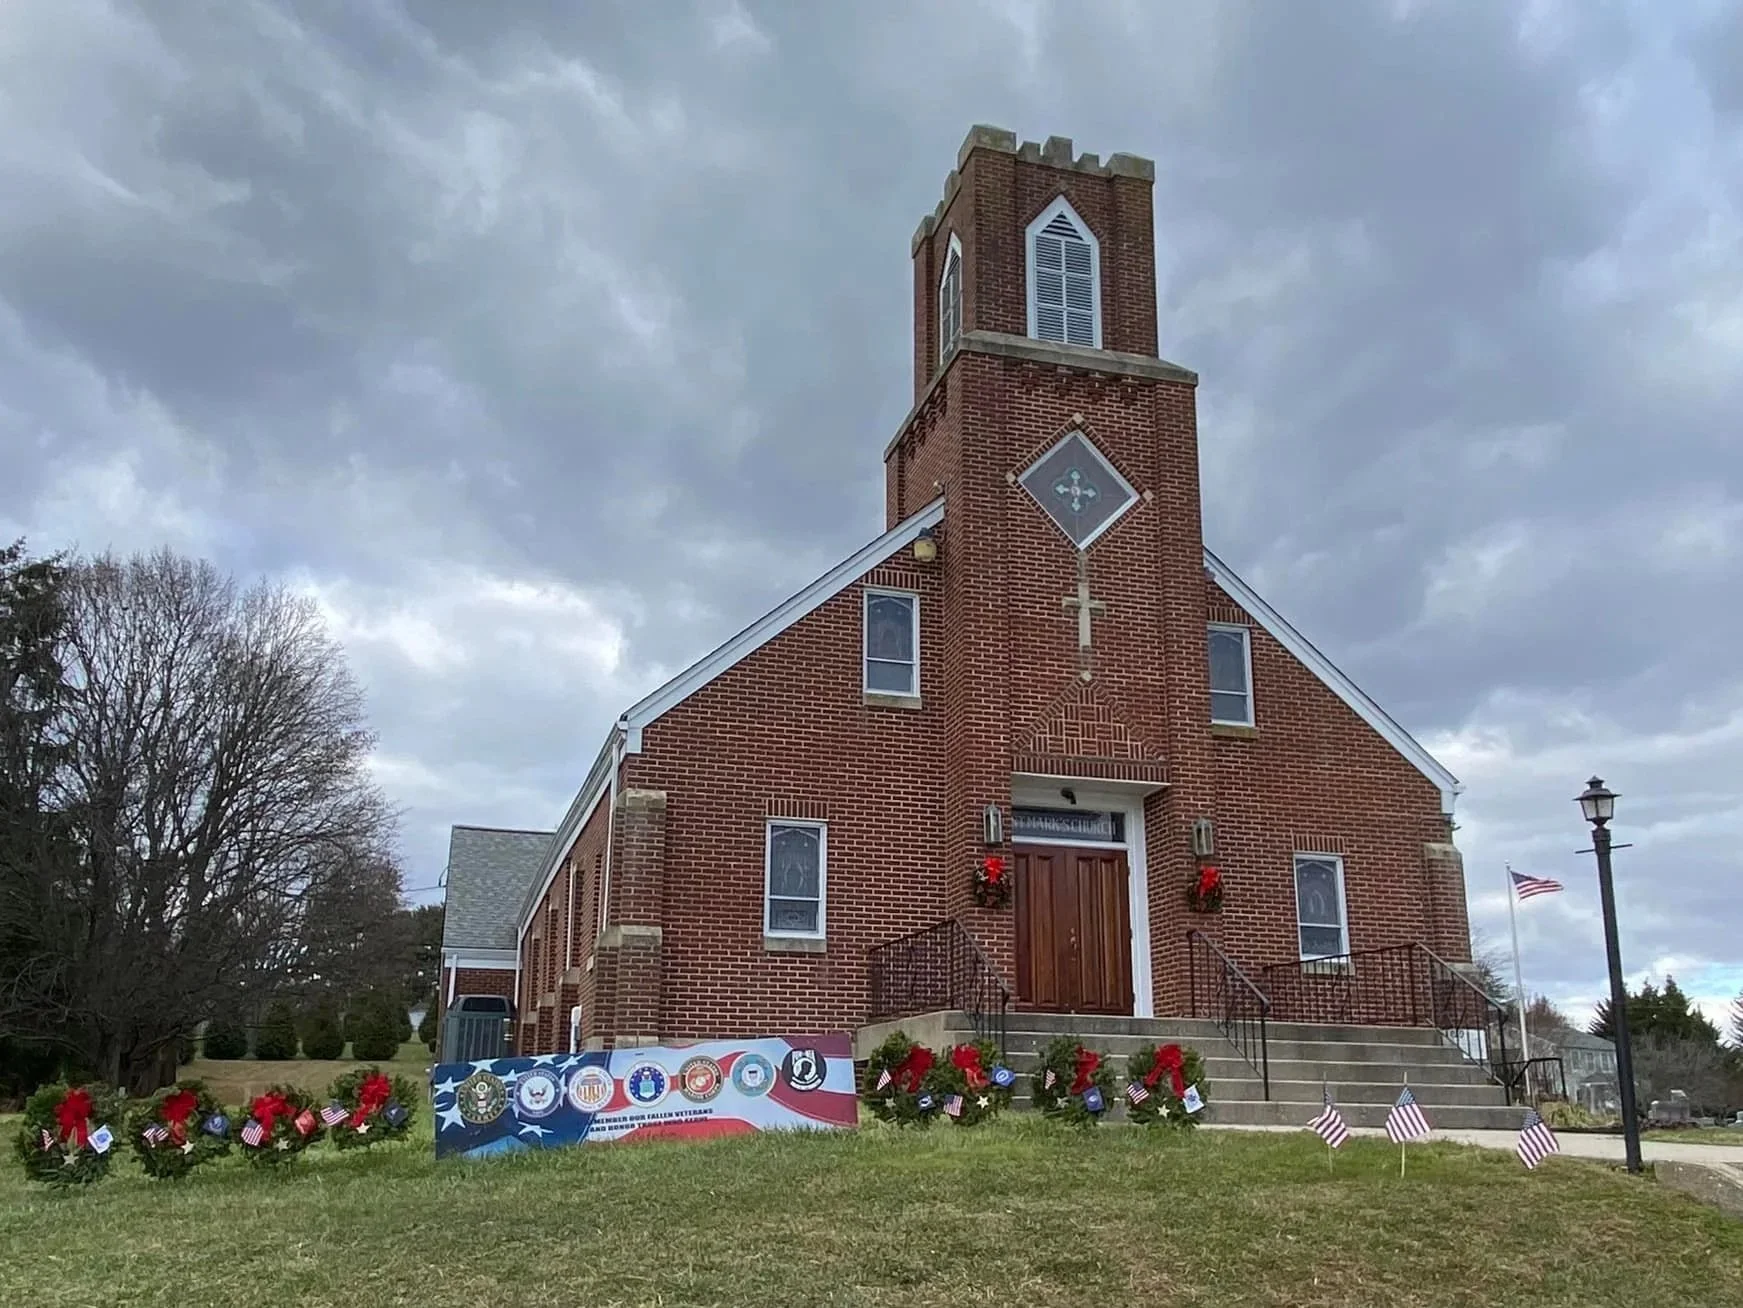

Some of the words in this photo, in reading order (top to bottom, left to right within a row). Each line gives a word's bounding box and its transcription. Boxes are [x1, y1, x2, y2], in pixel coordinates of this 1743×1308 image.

[647, 1111, 673, 1119] FALLEN
[674, 1108, 713, 1117] VETERANS
[608, 1123, 636, 1131] HONOR
